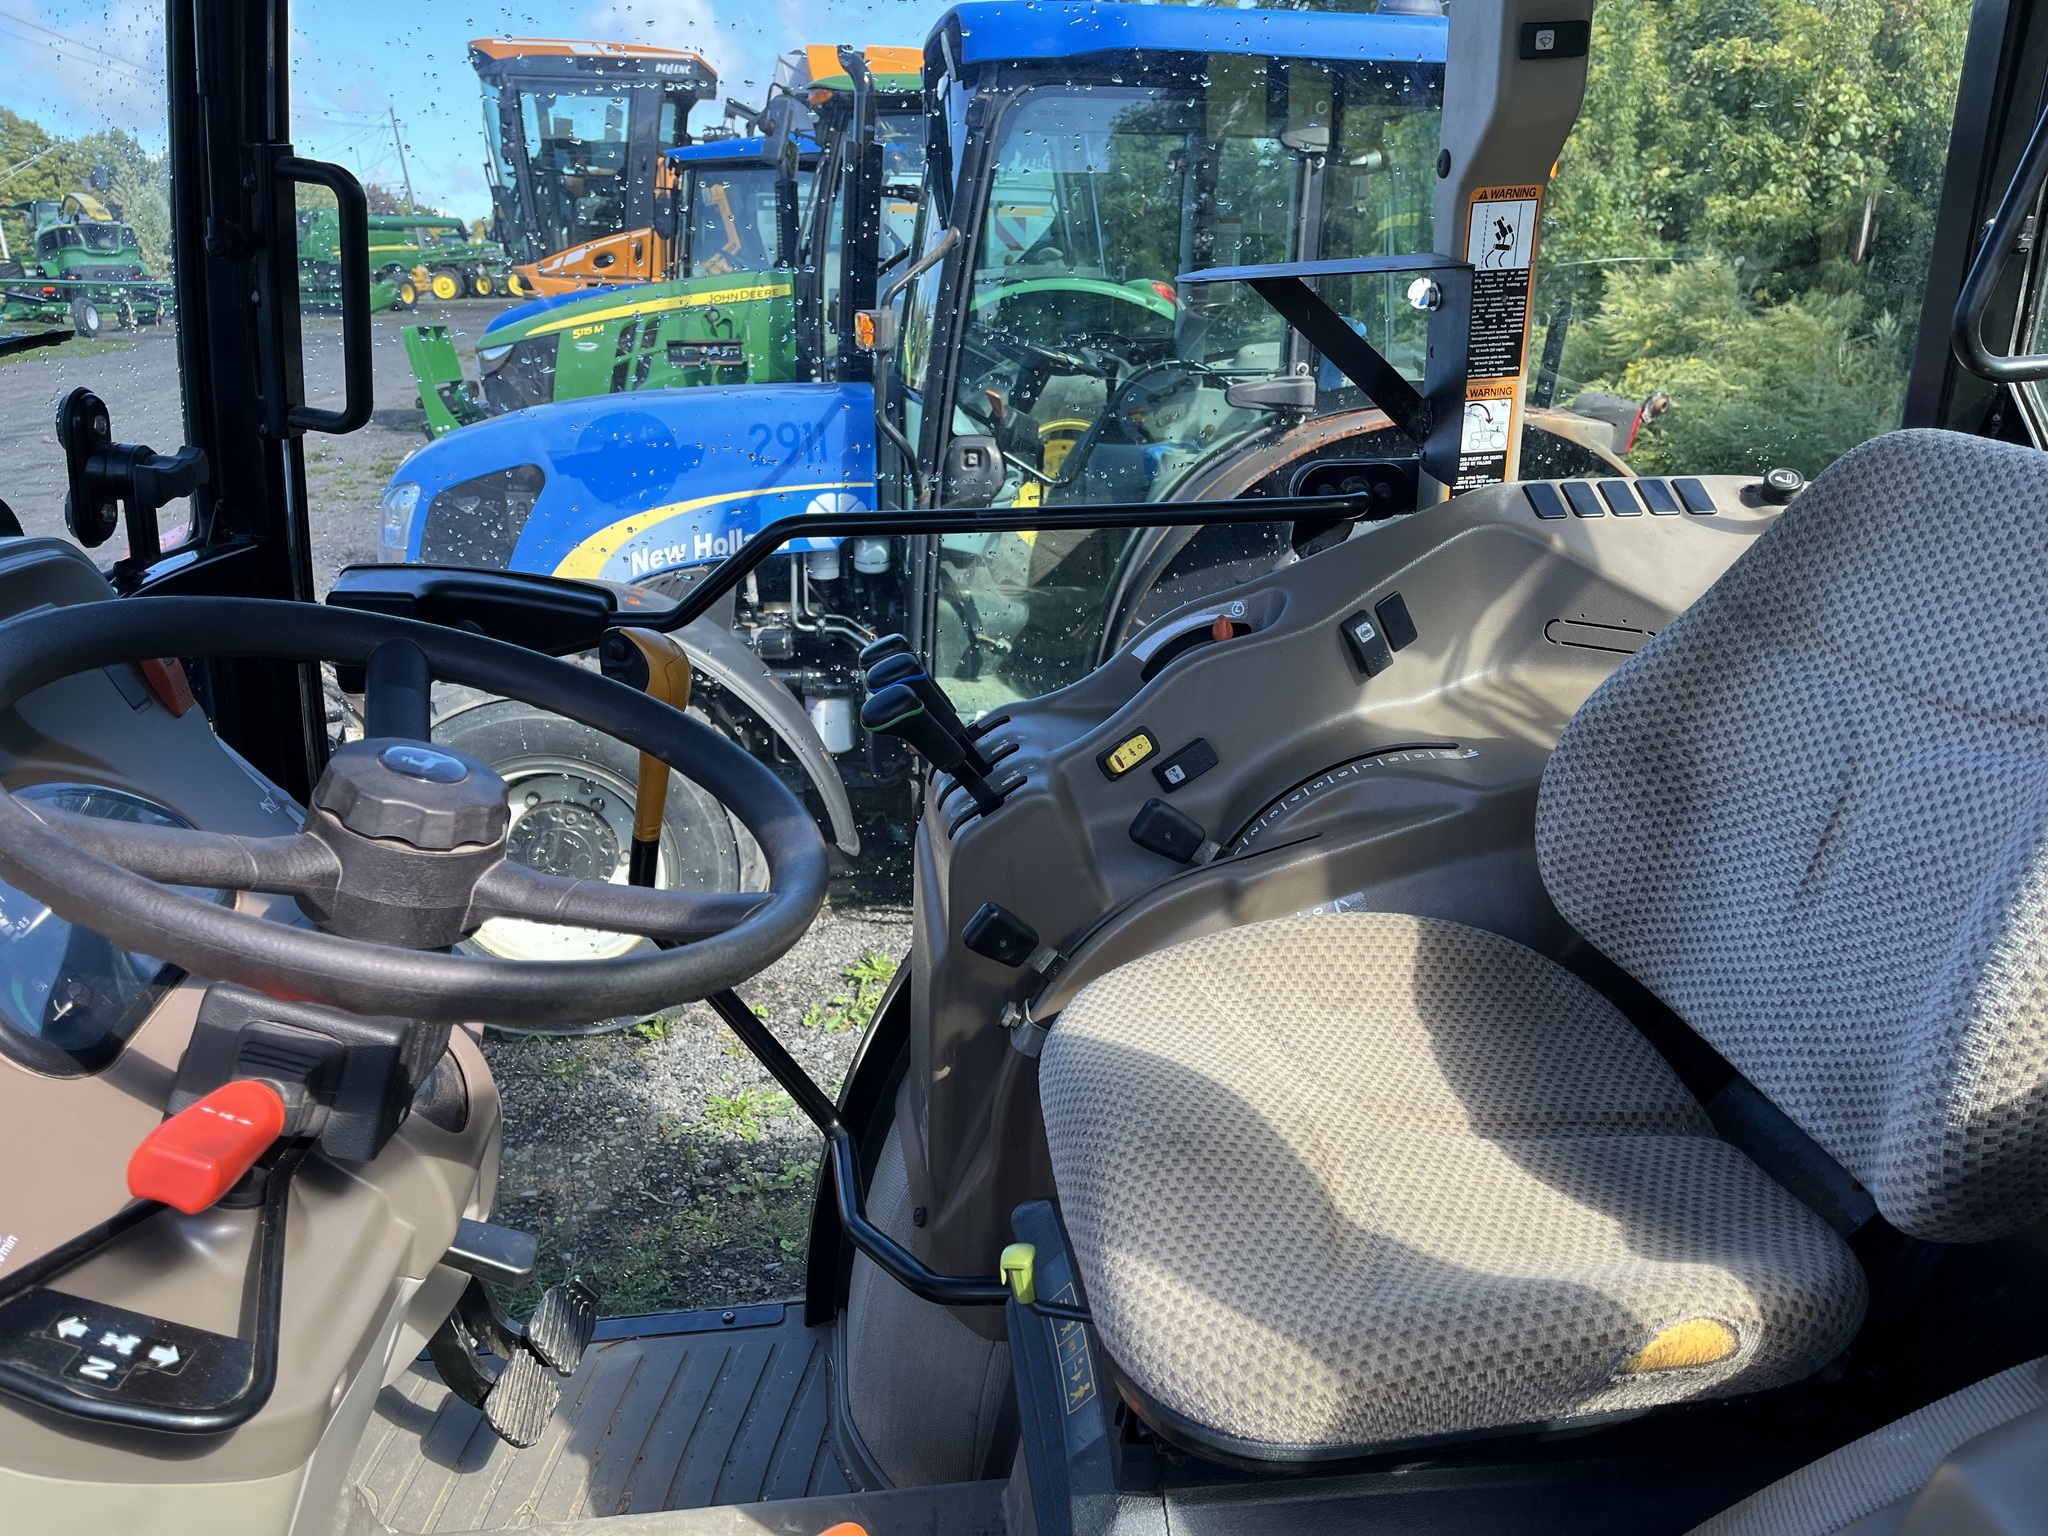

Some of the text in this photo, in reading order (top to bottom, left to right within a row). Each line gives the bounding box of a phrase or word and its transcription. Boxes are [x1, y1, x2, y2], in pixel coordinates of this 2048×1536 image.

[1491, 188, 1537, 199] WARNING
[709, 289, 779, 303] JOHN DEERE
[1470, 387, 1513, 398] WARNING
[749, 421, 827, 467] 2911
[630, 543, 686, 576] New
[79, 1355, 117, 1380] N
